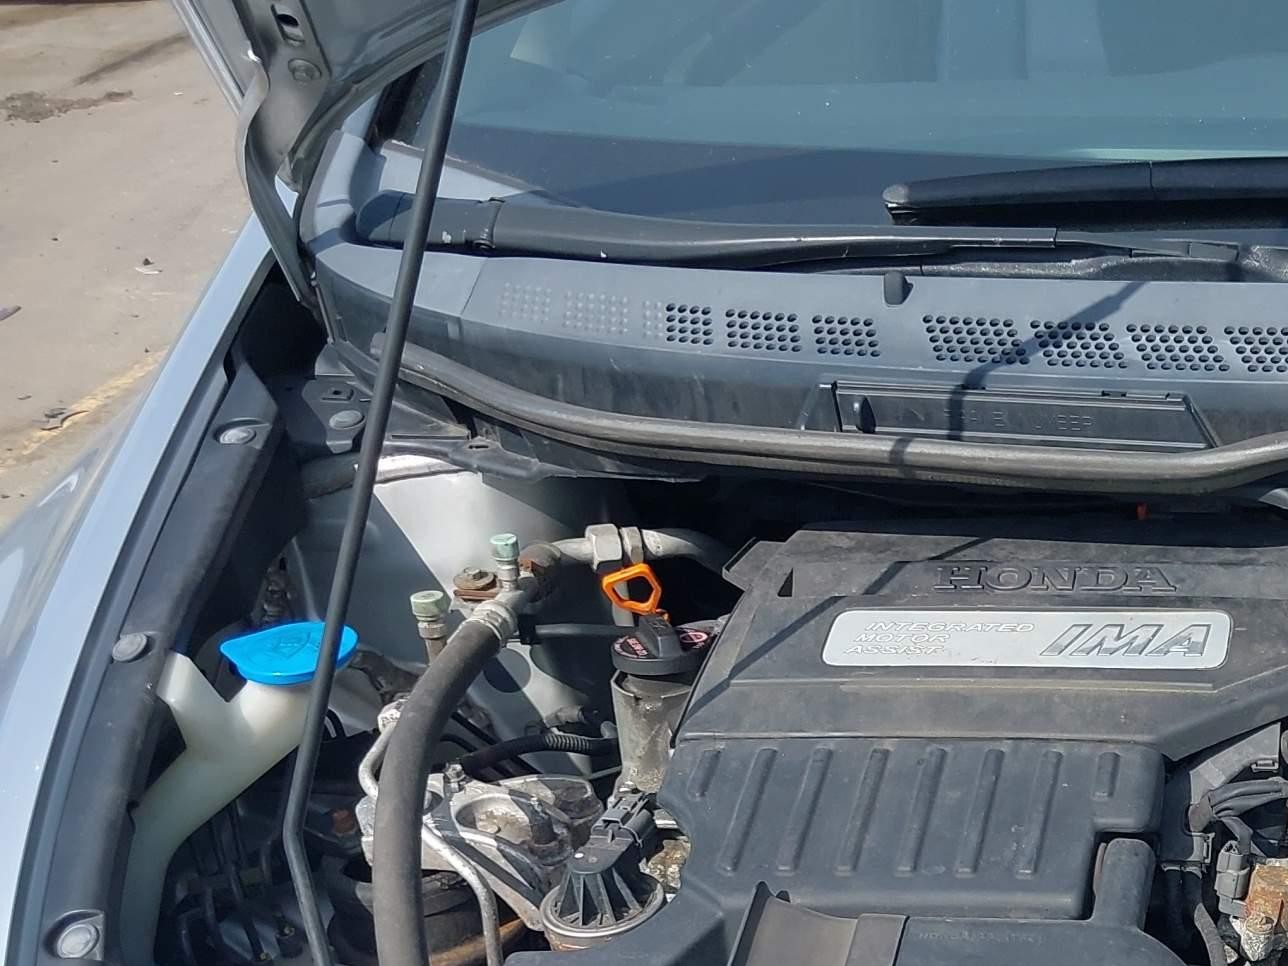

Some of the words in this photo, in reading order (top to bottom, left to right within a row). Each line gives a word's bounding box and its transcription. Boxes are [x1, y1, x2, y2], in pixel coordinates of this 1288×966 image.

[934, 566, 1177, 593] HONDA
[864, 622, 1034, 632] INTEGRATED
[855, 633, 951, 643] MOTOR
[1040, 623, 1211, 656] IMA
[843, 645, 944, 655] ASSIST
